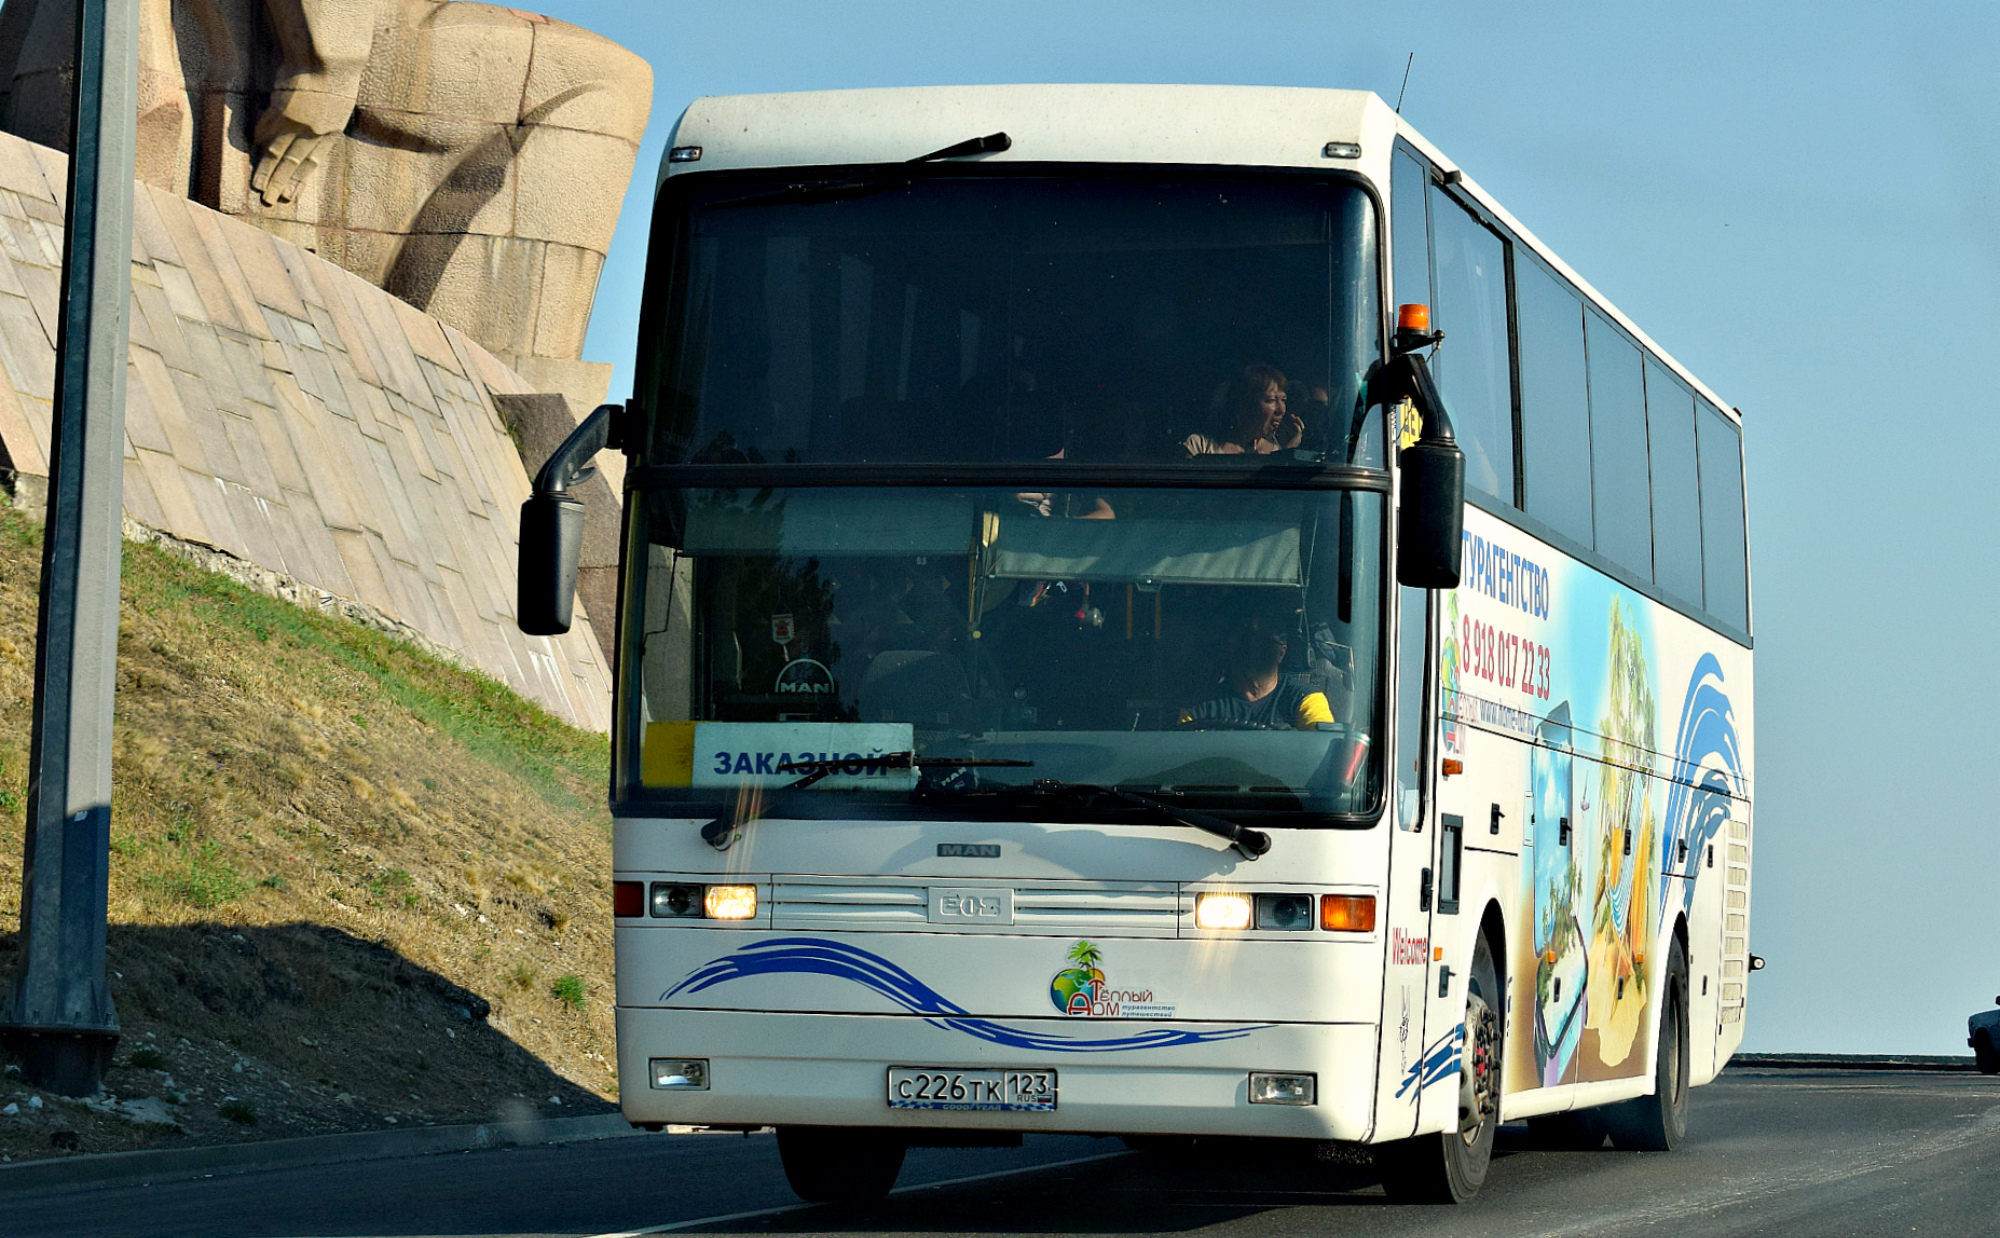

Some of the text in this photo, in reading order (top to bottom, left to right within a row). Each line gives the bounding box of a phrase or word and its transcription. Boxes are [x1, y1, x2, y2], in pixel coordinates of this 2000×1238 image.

[1463, 529, 1549, 621] ТУРАГЕНТСТВО
[1463, 614, 1470, 673] 8
[1474, 619, 1494, 682] 918
[1498, 630, 1518, 688] 017
[1522, 638, 1534, 695] 22
[1537, 644, 1550, 701] 33
[780, 682, 829, 693] MAN
[942, 846, 996, 856] MAN
[940, 896, 1001, 917] EOS
[1392, 927, 1427, 965] Welcome
[1009, 1073, 1049, 1095] 123
[1016, 1094, 1037, 1103] RUS
